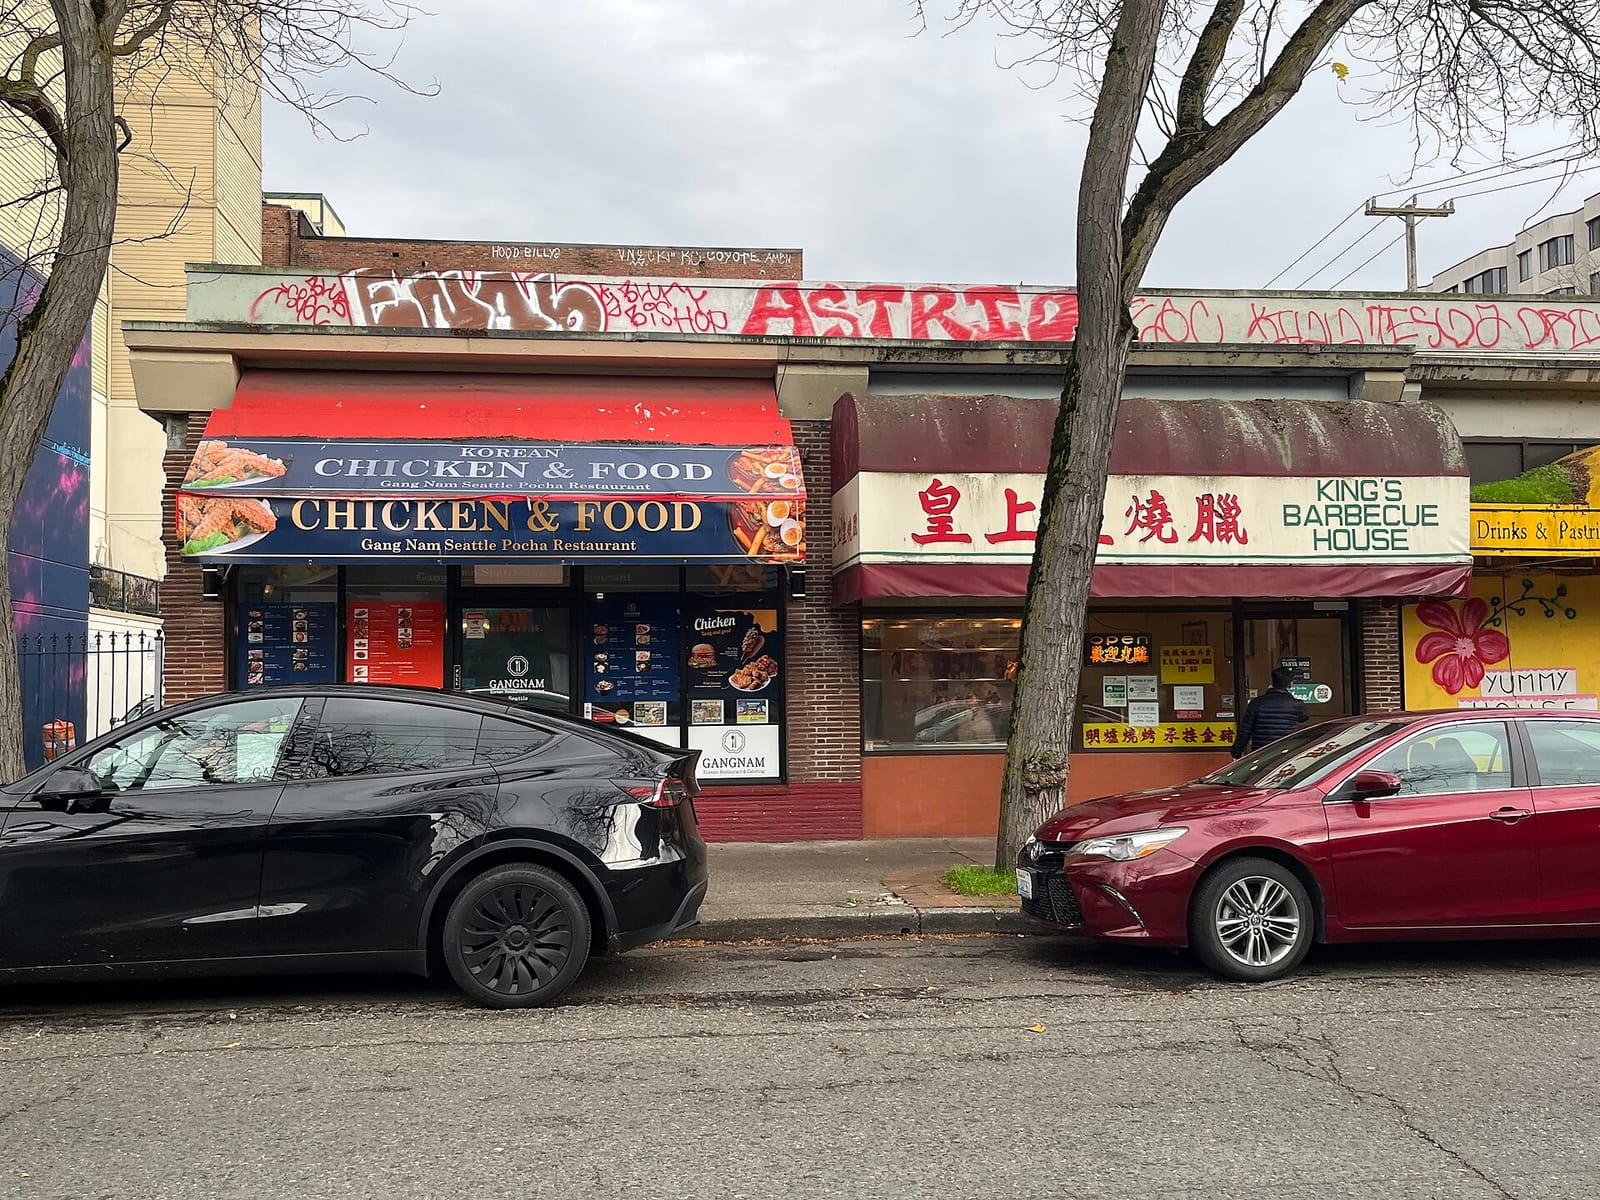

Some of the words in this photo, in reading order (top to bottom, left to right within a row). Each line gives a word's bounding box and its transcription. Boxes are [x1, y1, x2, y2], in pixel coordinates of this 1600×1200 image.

[492, 245, 520, 260] HOOD
[460, 447, 560, 458] KOREAN
[314, 458, 531, 479] CHICKEN
[542, 461, 575, 479] &
[588, 462, 713, 480] FOOD
[380, 480, 419, 489] Gang
[423, 480, 458, 488] Nam
[461, 480, 513, 489] Seattle
[513, 481, 564, 490] Pocha
[569, 482, 651, 491] Restaurant
[1317, 478, 1403, 502] KING'S
[291, 500, 513, 532] CHICKEN
[526, 500, 560, 532] &
[573, 501, 702, 532] FOOD
[911, 478, 1249, 546] 皇上燒臘
[1283, 504, 1439, 527] BARBECUE
[1313, 528, 1409, 551] HOUSE
[1476, 519, 1528, 540] Drinks
[1535, 522, 1548, 540] &
[361, 538, 401, 553] Gang
[405, 538, 441, 551] Nam
[444, 538, 497, 551] Seattle
[501, 538, 548, 551] Pocha
[553, 538, 637, 551] Restaurant
[694, 616, 736, 631] Chicken
[489, 679, 545, 689] GANGNAM
[1486, 671, 1568, 694] YUMMY
[702, 756, 765, 769] GANGNAM
